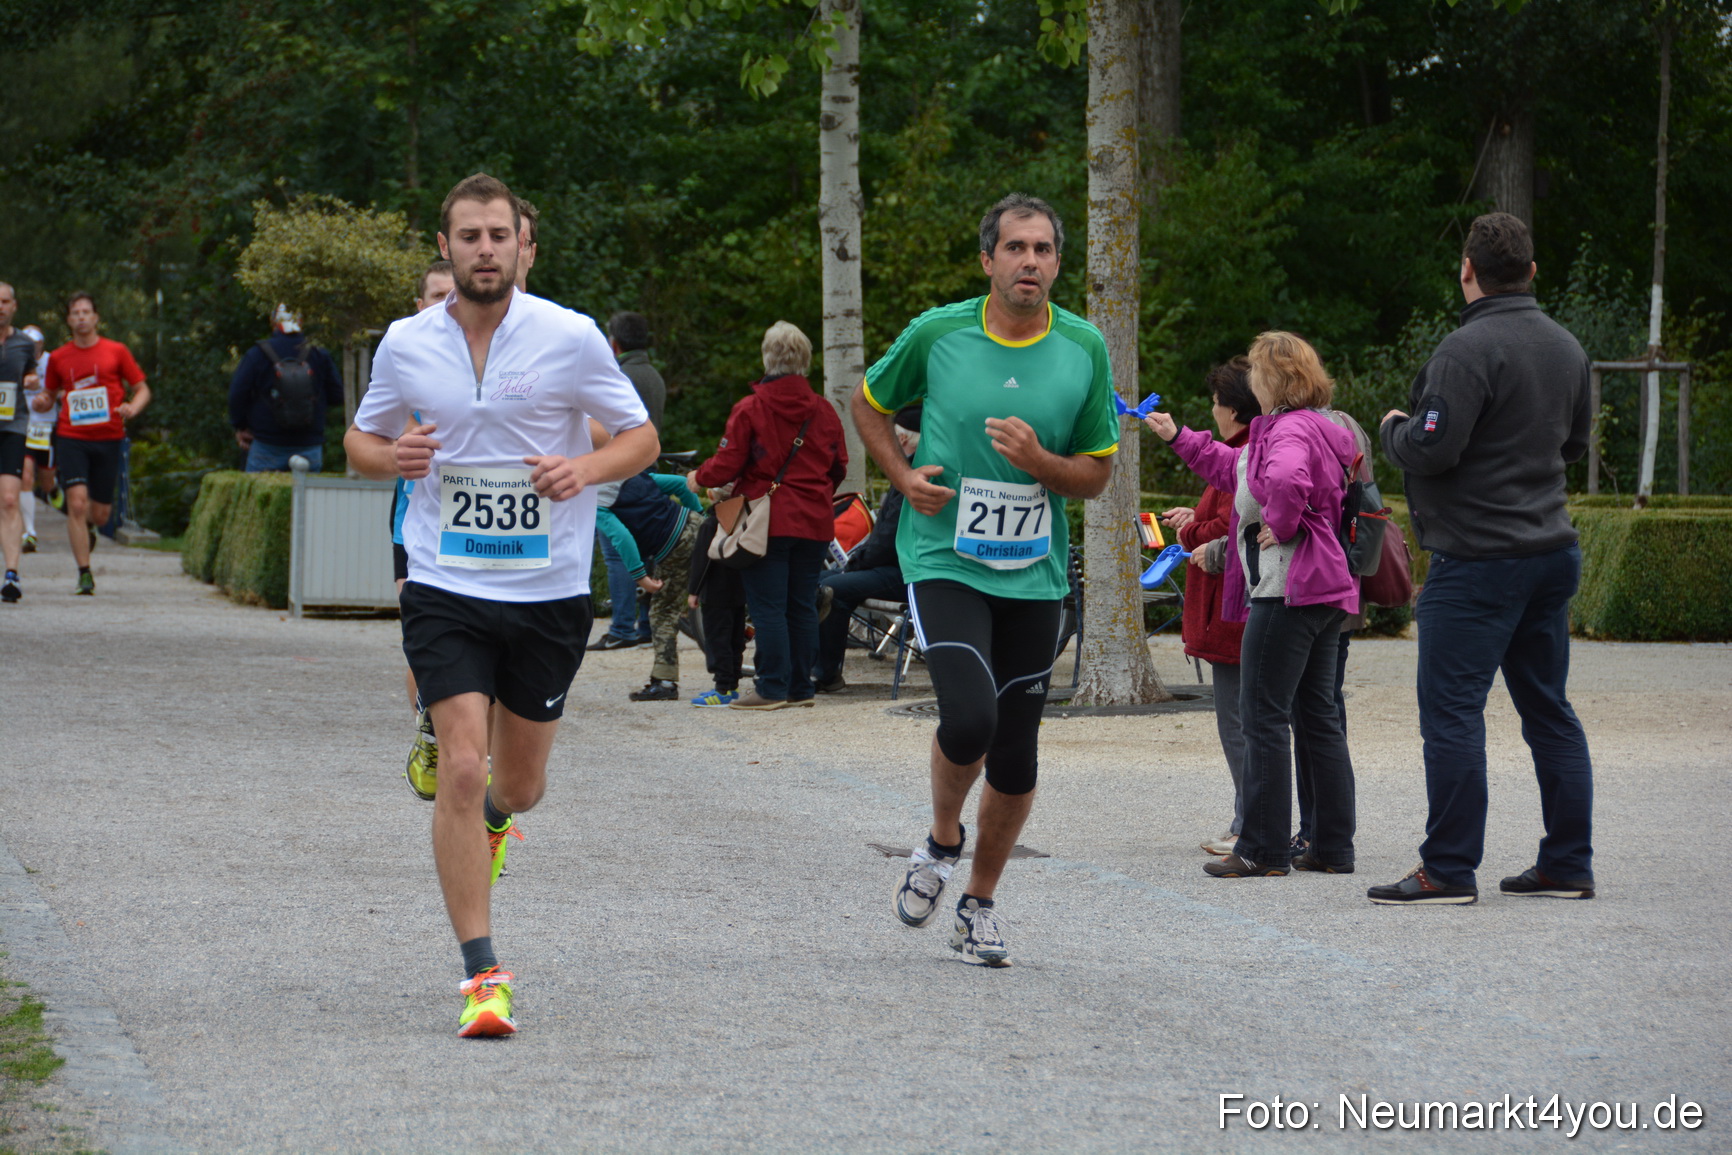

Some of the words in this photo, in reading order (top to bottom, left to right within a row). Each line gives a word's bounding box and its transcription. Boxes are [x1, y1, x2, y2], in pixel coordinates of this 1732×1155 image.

[490, 370, 539, 400] Julia
[73, 397, 104, 411] 2610
[443, 475, 477, 487] PARTL
[480, 479, 531, 488] Neumarkt
[963, 486, 996, 498] PARTL
[452, 491, 540, 530] 2538
[967, 501, 1045, 536] 2177
[465, 538, 523, 555] Dominik
[976, 543, 1032, 557] Christian
